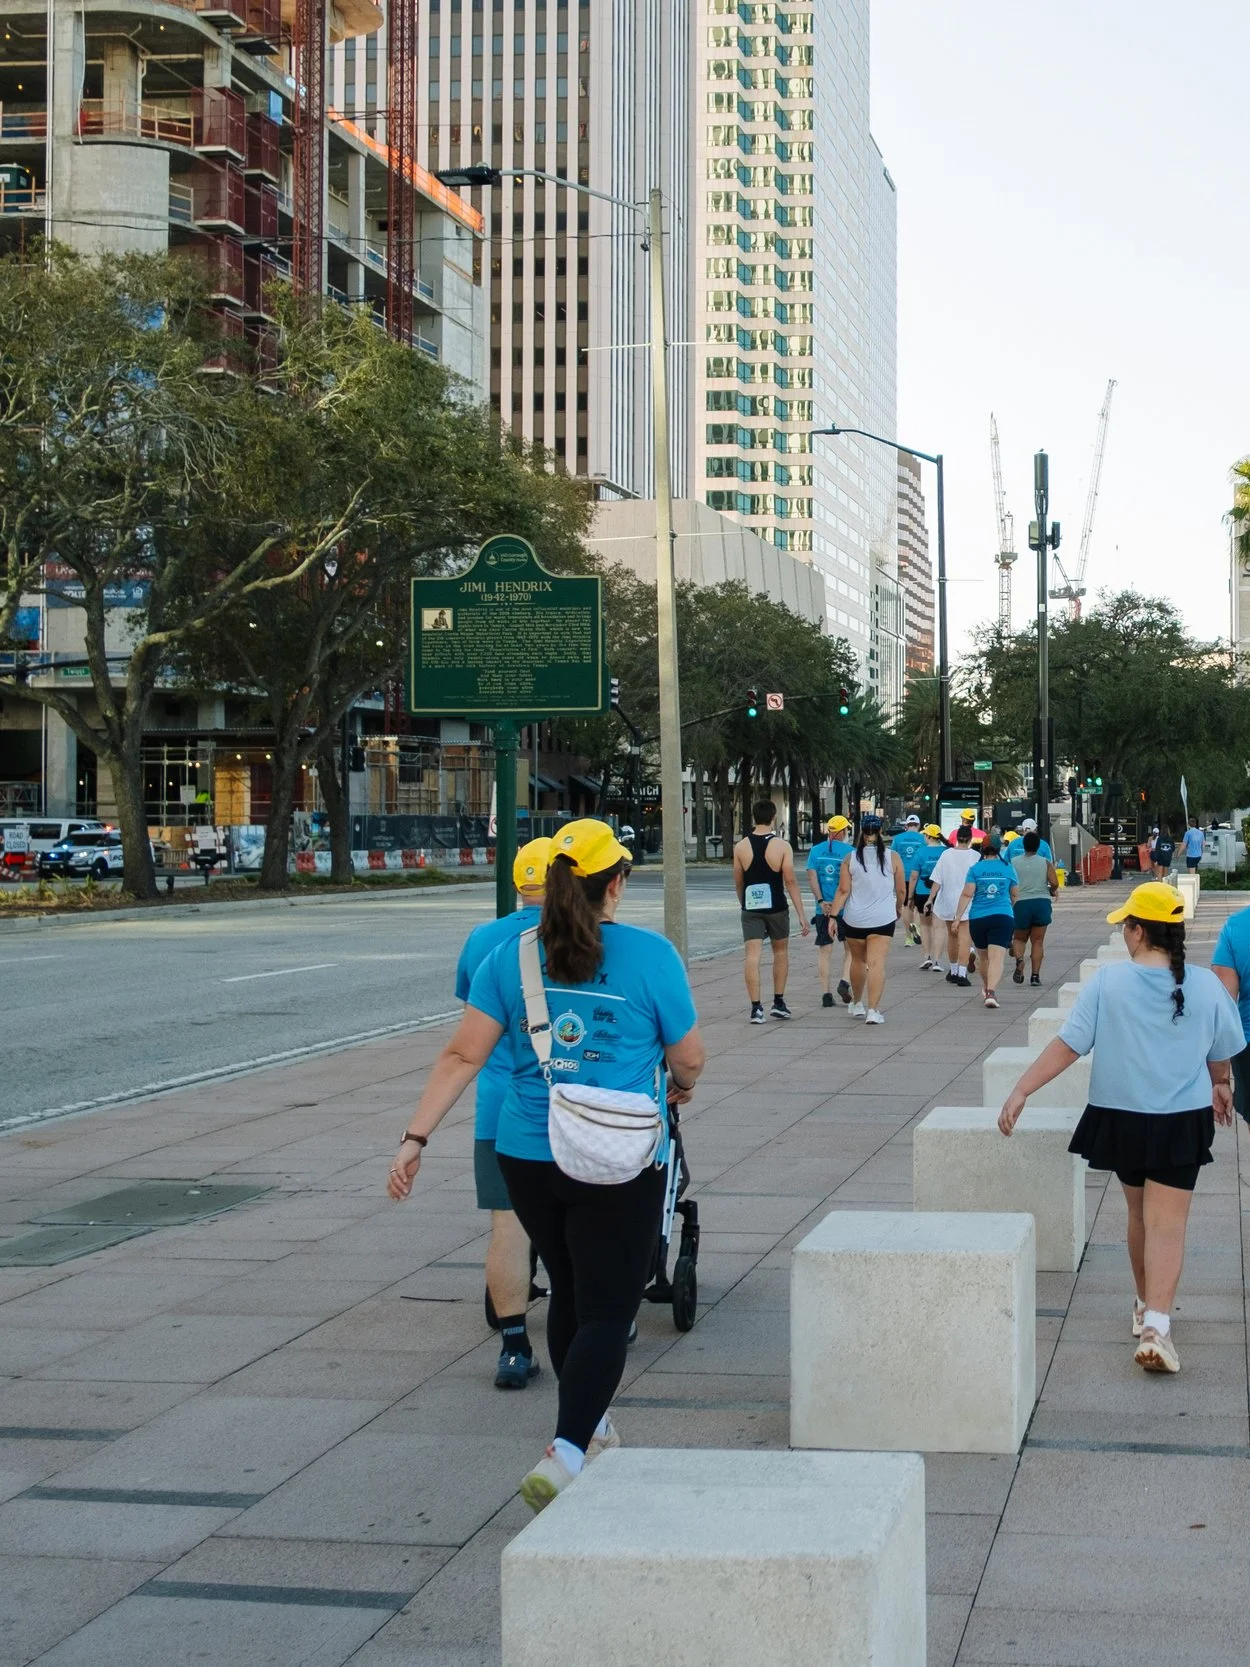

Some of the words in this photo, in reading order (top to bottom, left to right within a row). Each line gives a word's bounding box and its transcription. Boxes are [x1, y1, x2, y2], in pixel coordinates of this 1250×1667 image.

[460, 582, 486, 592] JIMI
[495, 581, 553, 592] HENDRIX
[480, 593, 532, 601] (1942-1970)
[8, 831, 24, 839] ROAD
[6, 841, 26, 849] CLOSED
